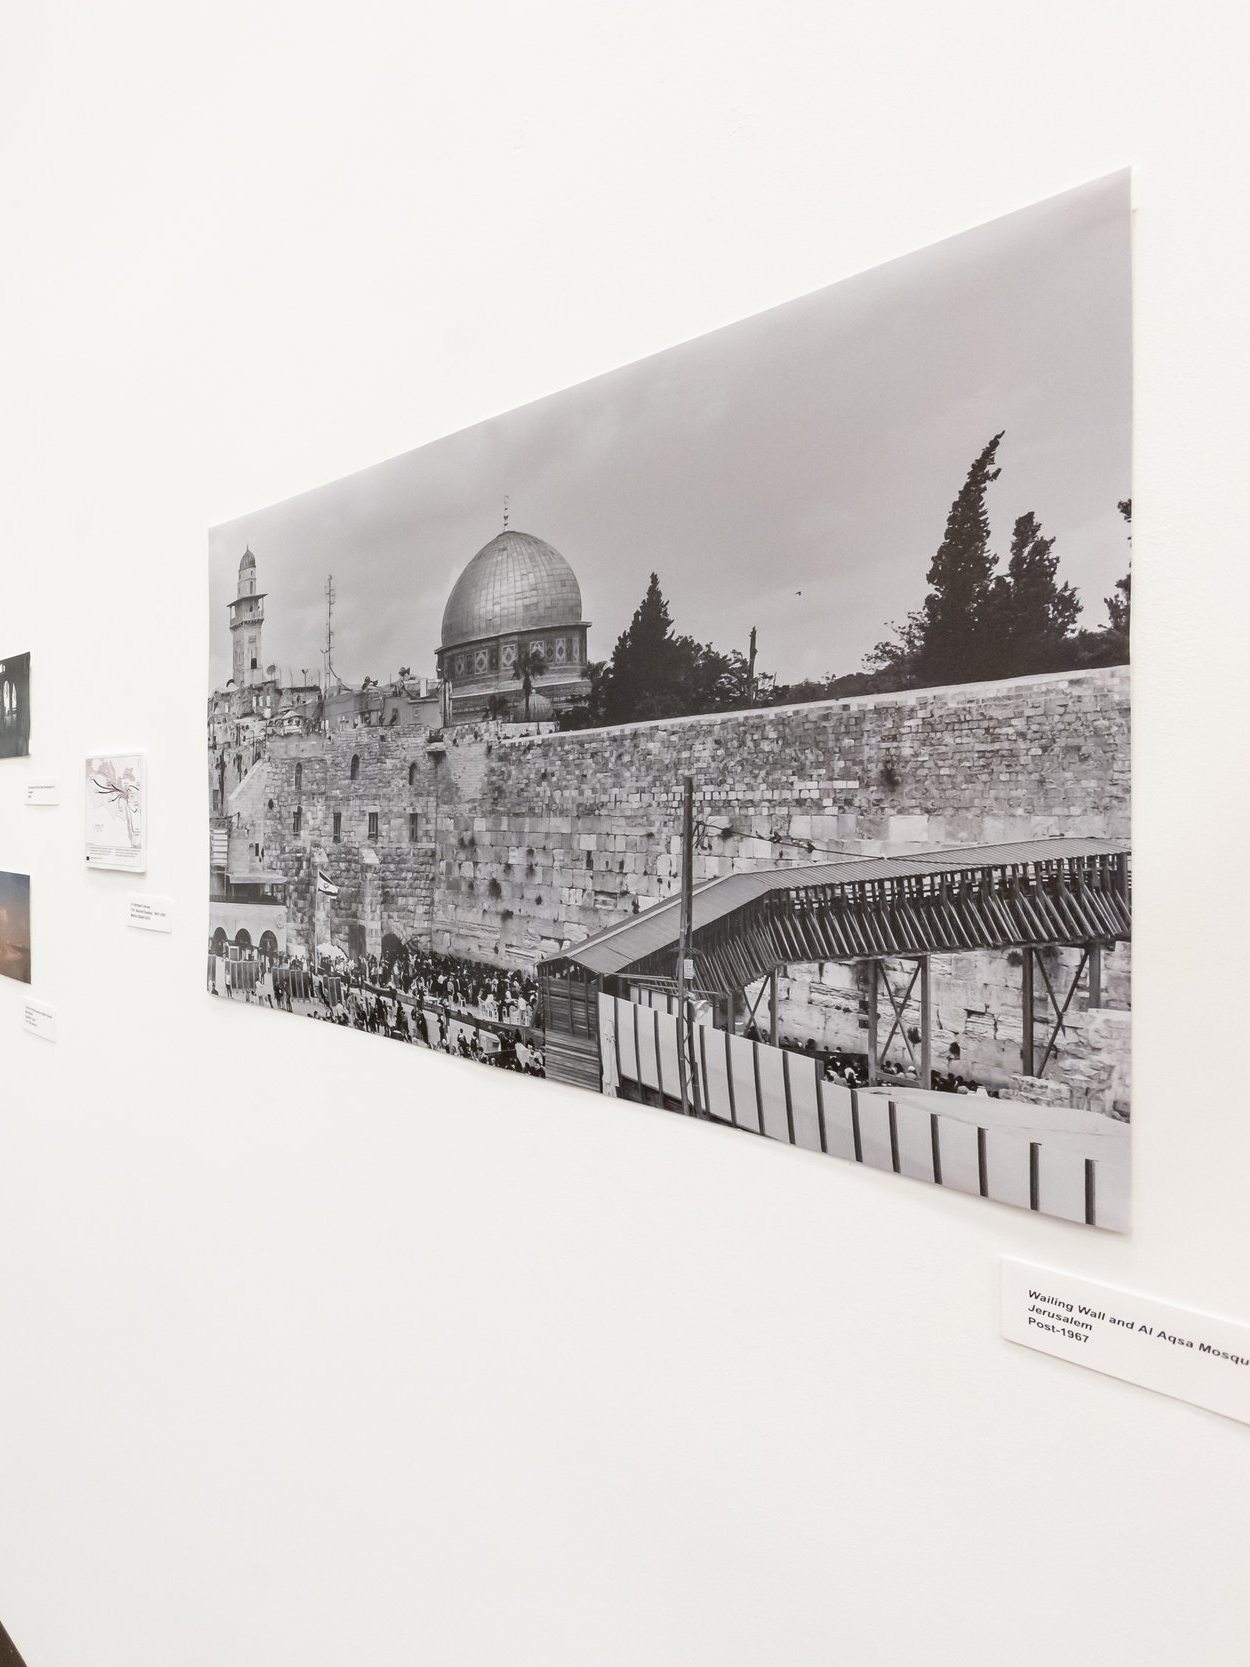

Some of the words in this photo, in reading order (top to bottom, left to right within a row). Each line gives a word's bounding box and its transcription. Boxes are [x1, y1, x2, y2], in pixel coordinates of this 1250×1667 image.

[1028, 1304, 1093, 1331] Jerusalem
[1028, 1290, 1074, 1312] Wailing
[1078, 1305, 1106, 1321] Wall
[1109, 1316, 1135, 1330] and
[1138, 1325, 1153, 1336] Al
[1157, 1330, 1194, 1349] Aqsa
[1198, 1343, 1250, 1366] Mosqu
[1028, 1316, 1090, 1343] Post-1967
